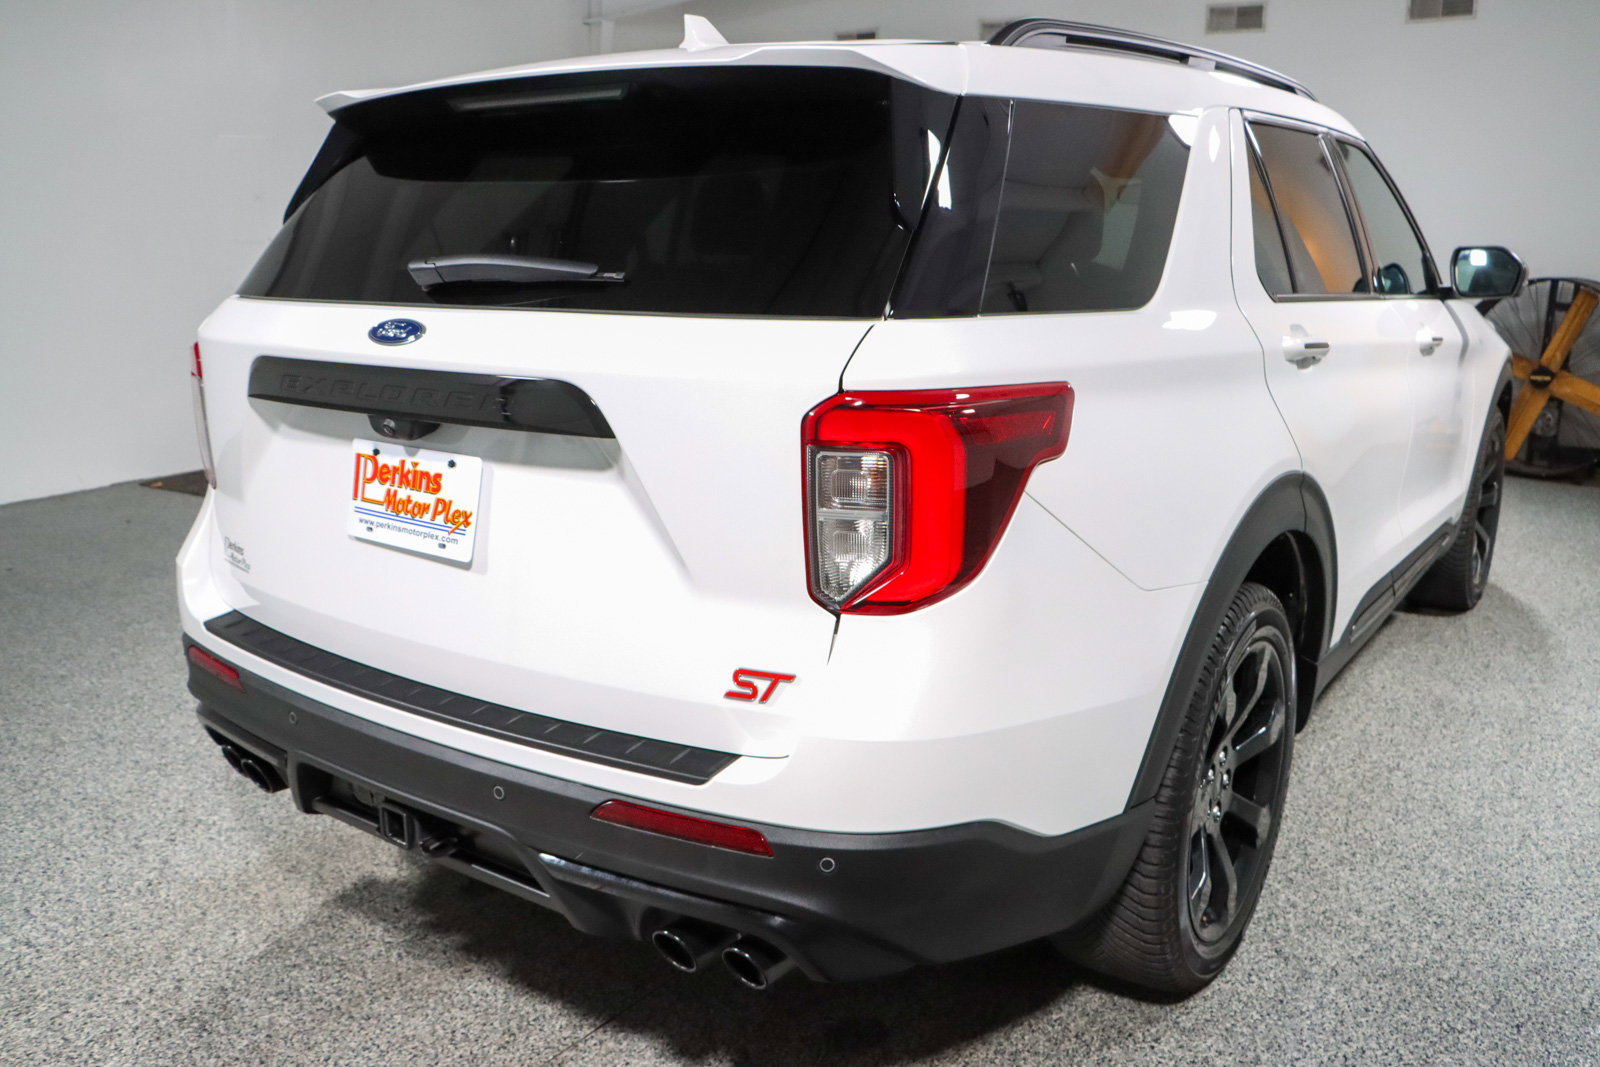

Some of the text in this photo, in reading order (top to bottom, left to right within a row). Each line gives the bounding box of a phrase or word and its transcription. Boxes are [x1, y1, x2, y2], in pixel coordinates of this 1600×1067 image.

[353, 452, 443, 505] Perkins
[358, 516, 459, 545] www.perkinsmotorplex.com
[384, 487, 473, 534] Motor Plex
[723, 667, 797, 704] ST
